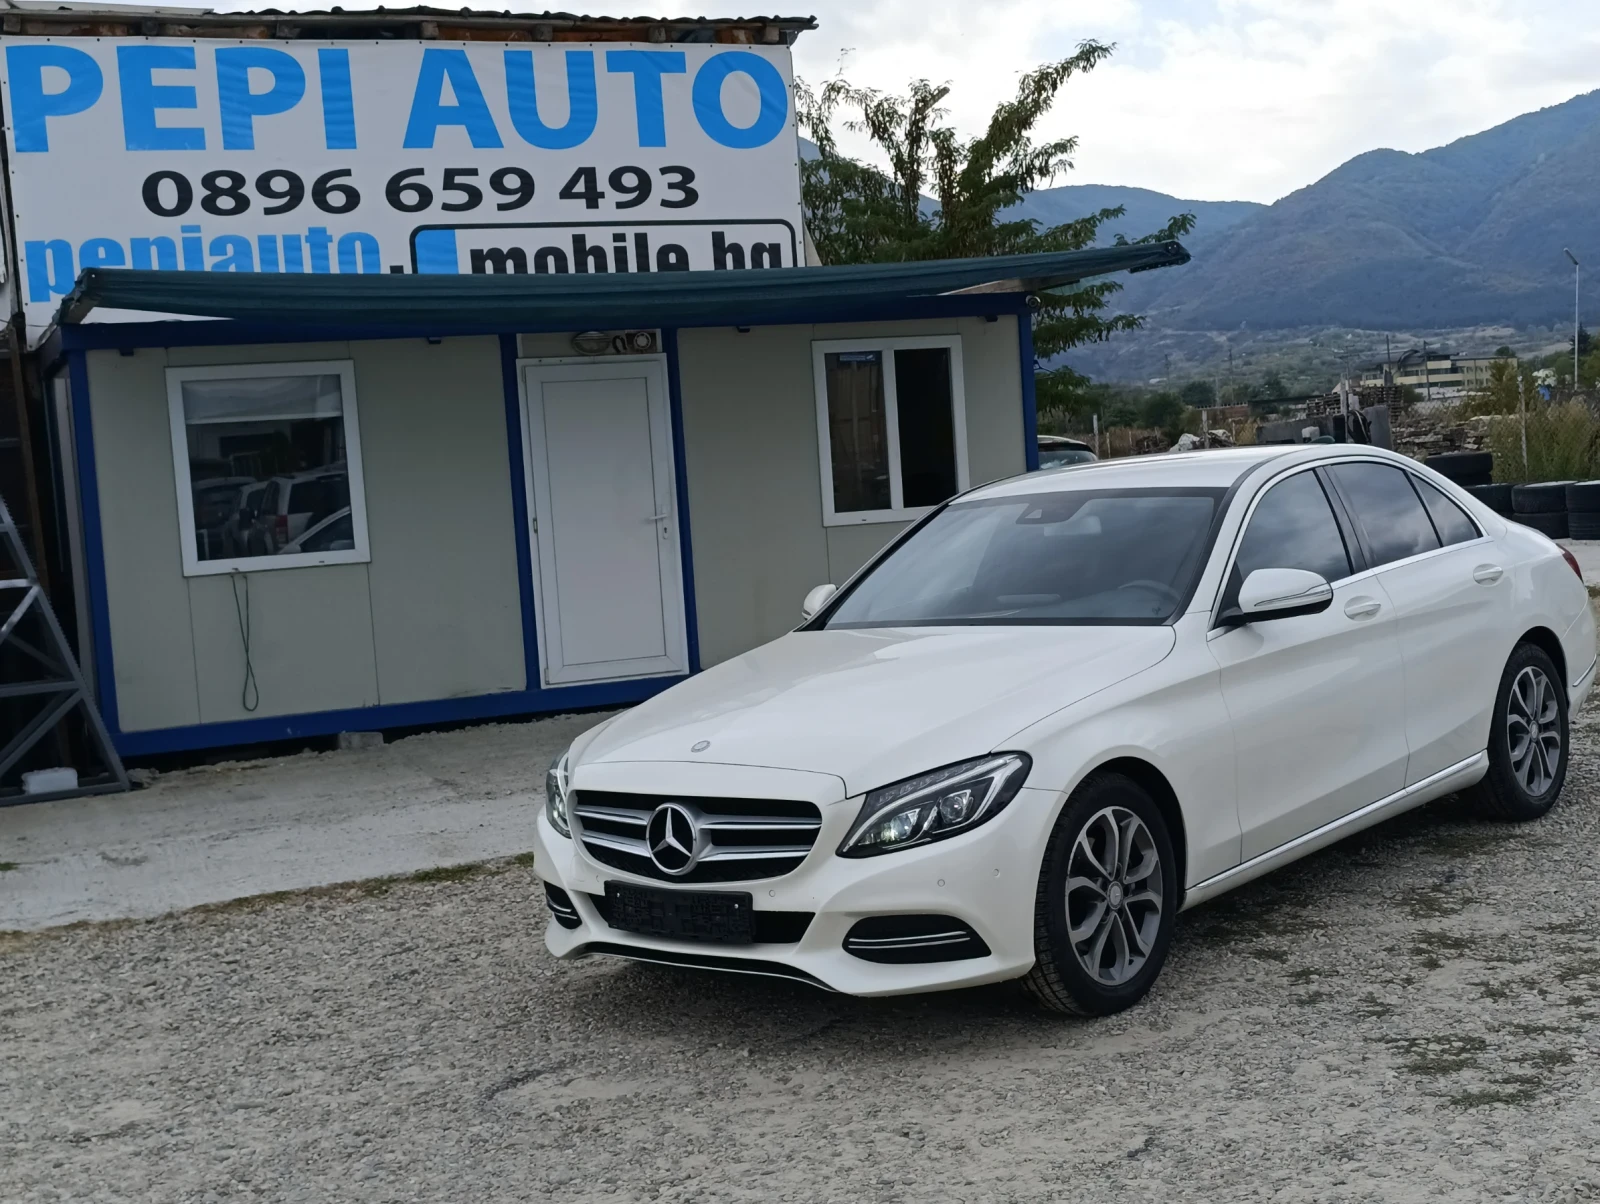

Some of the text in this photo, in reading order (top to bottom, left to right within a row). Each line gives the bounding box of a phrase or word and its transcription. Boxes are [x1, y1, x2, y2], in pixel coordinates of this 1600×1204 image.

[6, 45, 788, 152] PEPI AUTO
[142, 165, 699, 217] 0896 659 493
